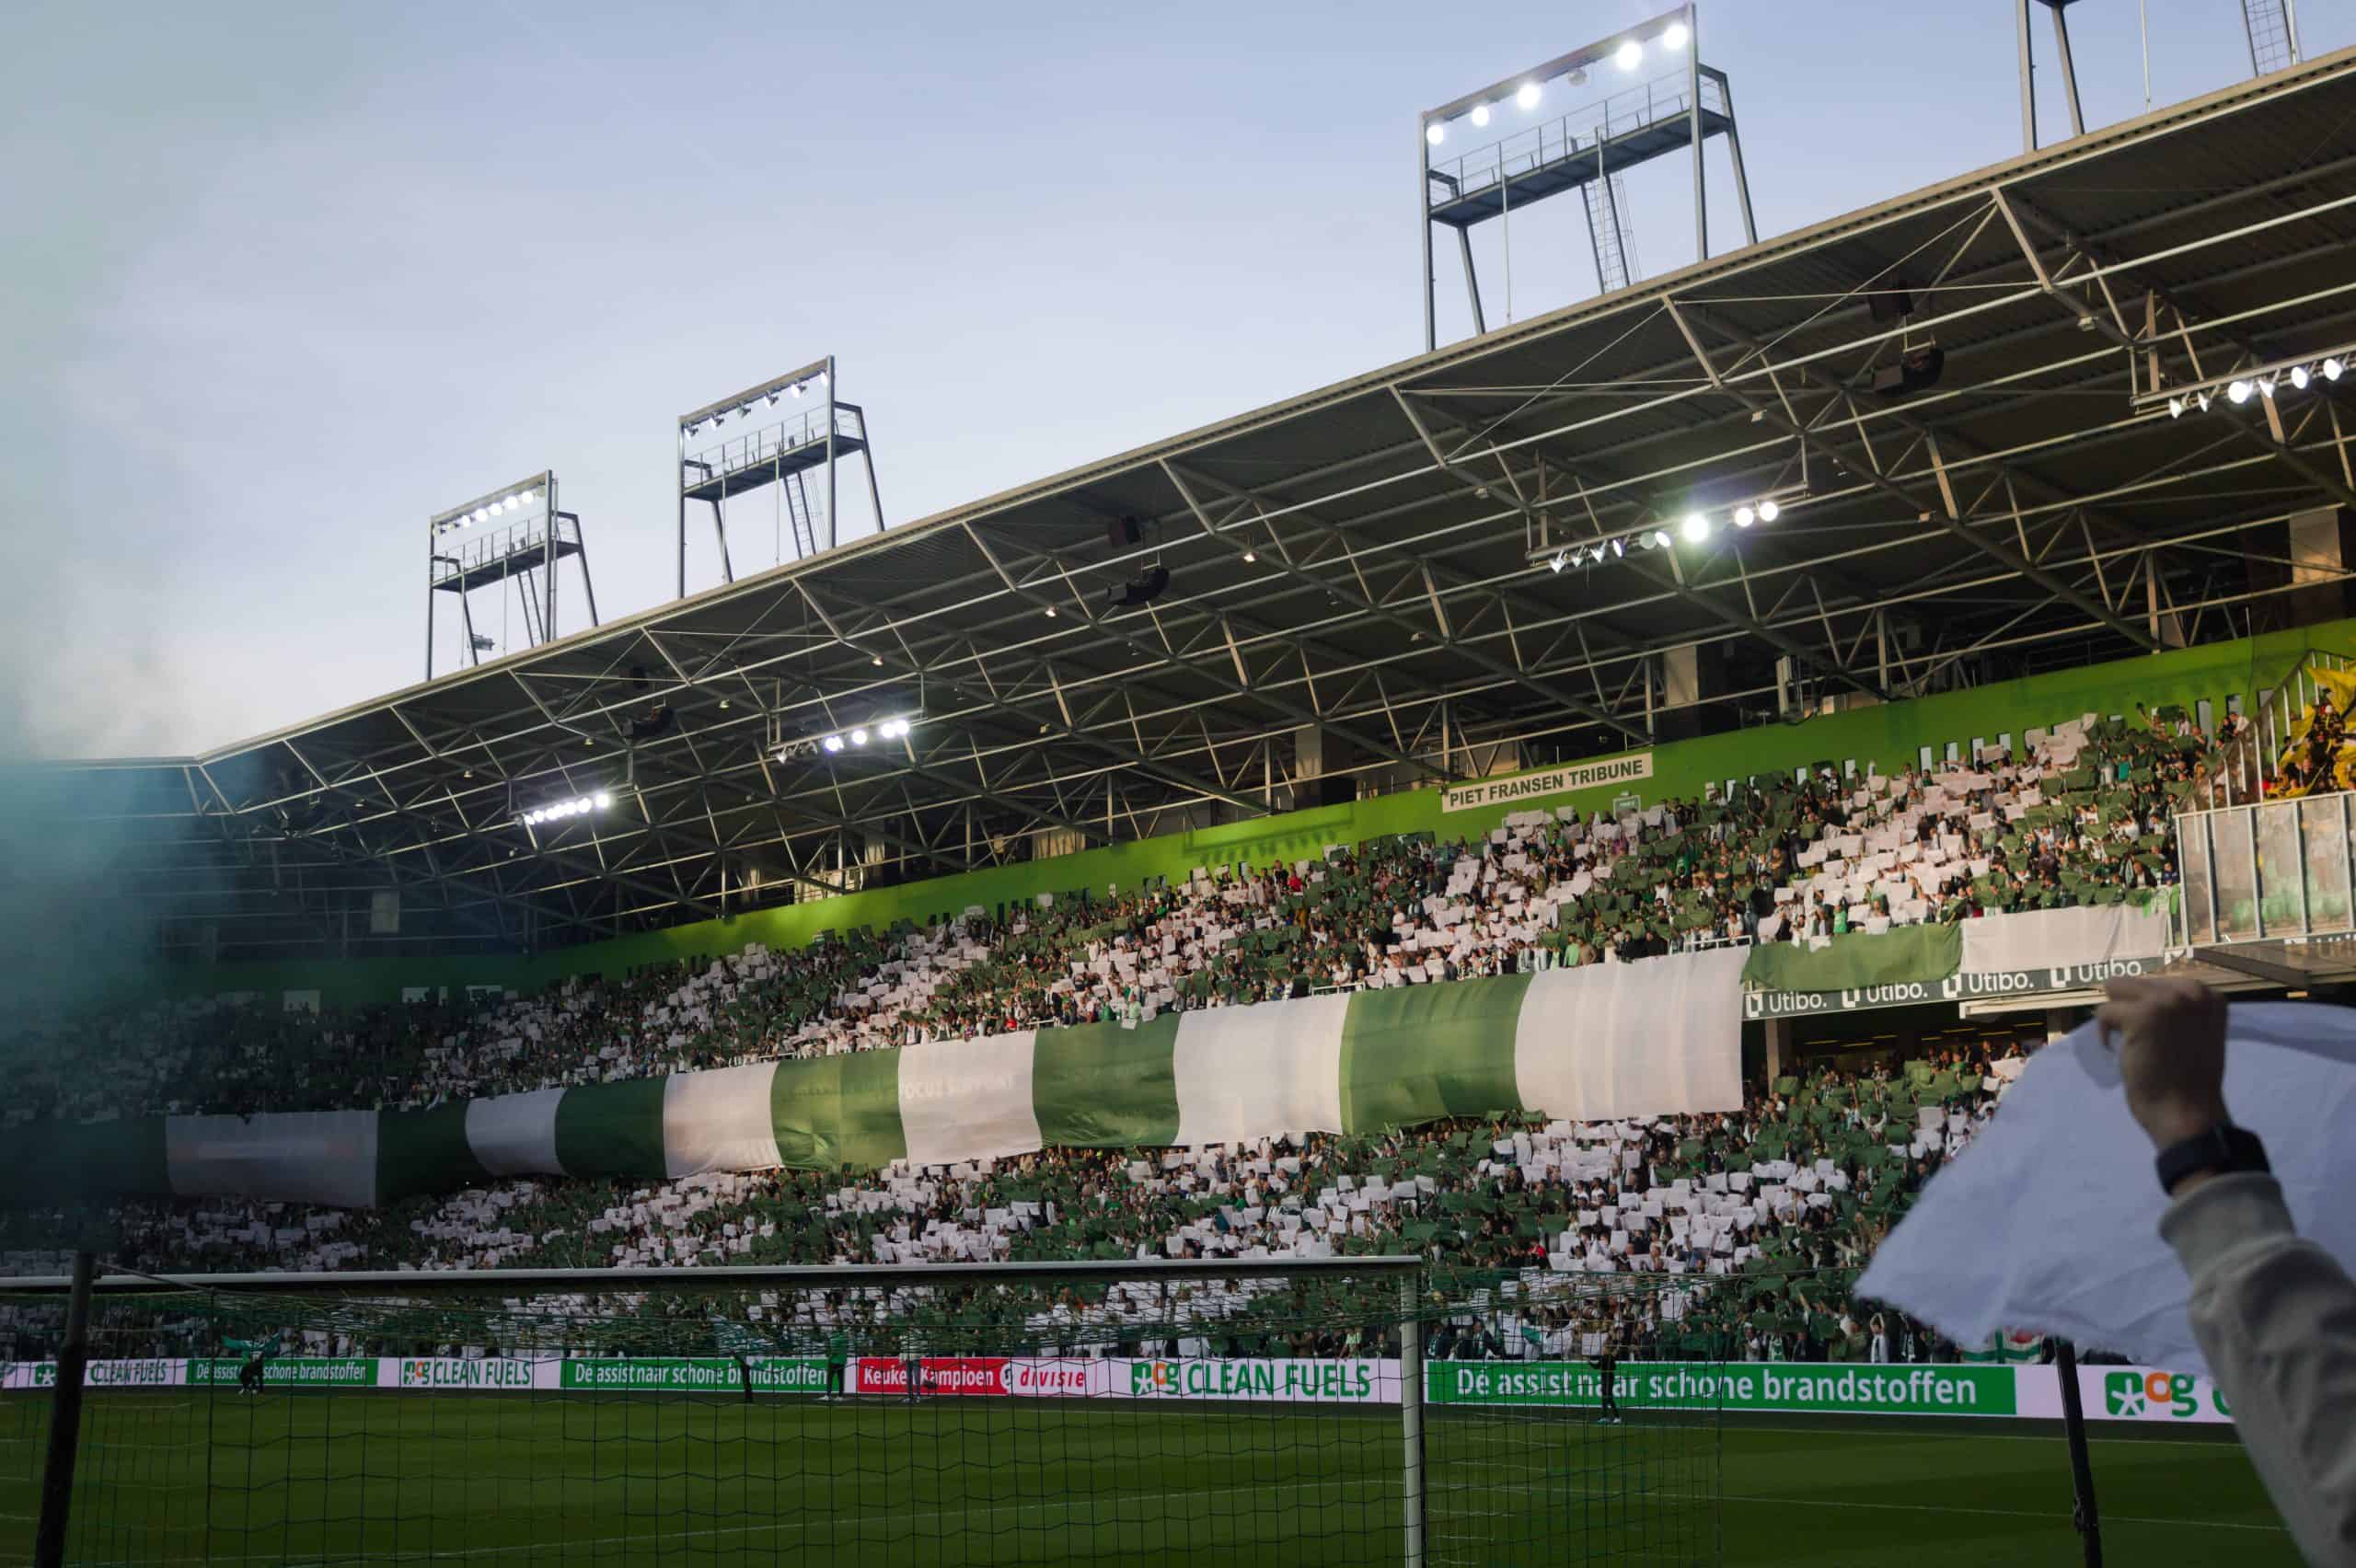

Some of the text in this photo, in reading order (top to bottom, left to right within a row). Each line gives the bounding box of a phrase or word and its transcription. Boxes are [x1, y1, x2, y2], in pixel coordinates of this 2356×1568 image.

[1449, 760, 1643, 807] PIET FRANSEN TRIBUNE
[1865, 982, 1929, 1003] Utibo.
[1969, 972, 2034, 993] Utibo.
[1769, 991, 1828, 1013] Utibo.
[90, 1362, 167, 1383] CLEAN FUELS
[263, 1361, 297, 1380] schone
[299, 1361, 366, 1381] brandstoffen
[434, 1362, 480, 1385] CLEAN
[486, 1361, 531, 1385] FUELS
[596, 1362, 635, 1383] assist
[636, 1366, 668, 1383] naar
[672, 1363, 723, 1384] schone
[920, 1365, 994, 1391] Kampioen
[1021, 1366, 1085, 1387] divisie
[1187, 1364, 1274, 1396] CLEAN
[1286, 1364, 1370, 1397] FUELS
[1497, 1368, 1573, 1398] assist
[1649, 1368, 1753, 1401] schone
[1763, 1368, 1977, 1405] brandstoffen
